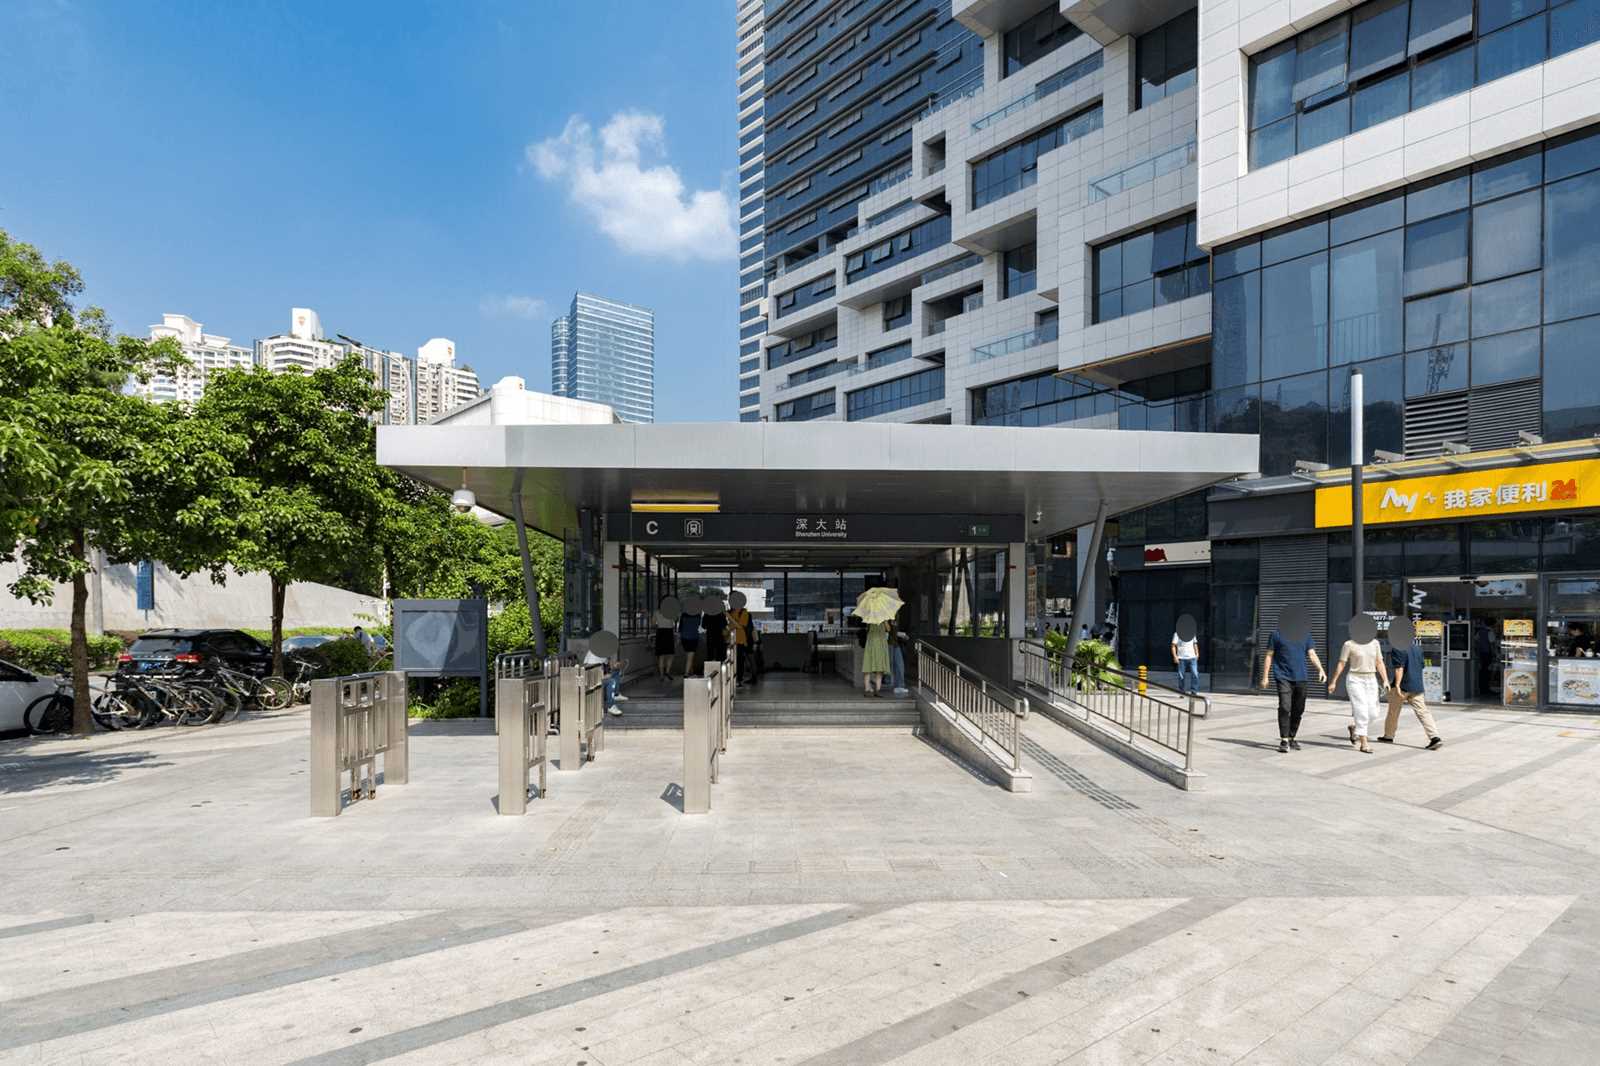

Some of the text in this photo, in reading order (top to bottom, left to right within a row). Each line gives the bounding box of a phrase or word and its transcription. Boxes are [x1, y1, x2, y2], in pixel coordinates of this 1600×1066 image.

[1444, 480, 1548, 510] 我家便利
[646, 520, 658, 535] C
[795, 518, 847, 530] 深大站
